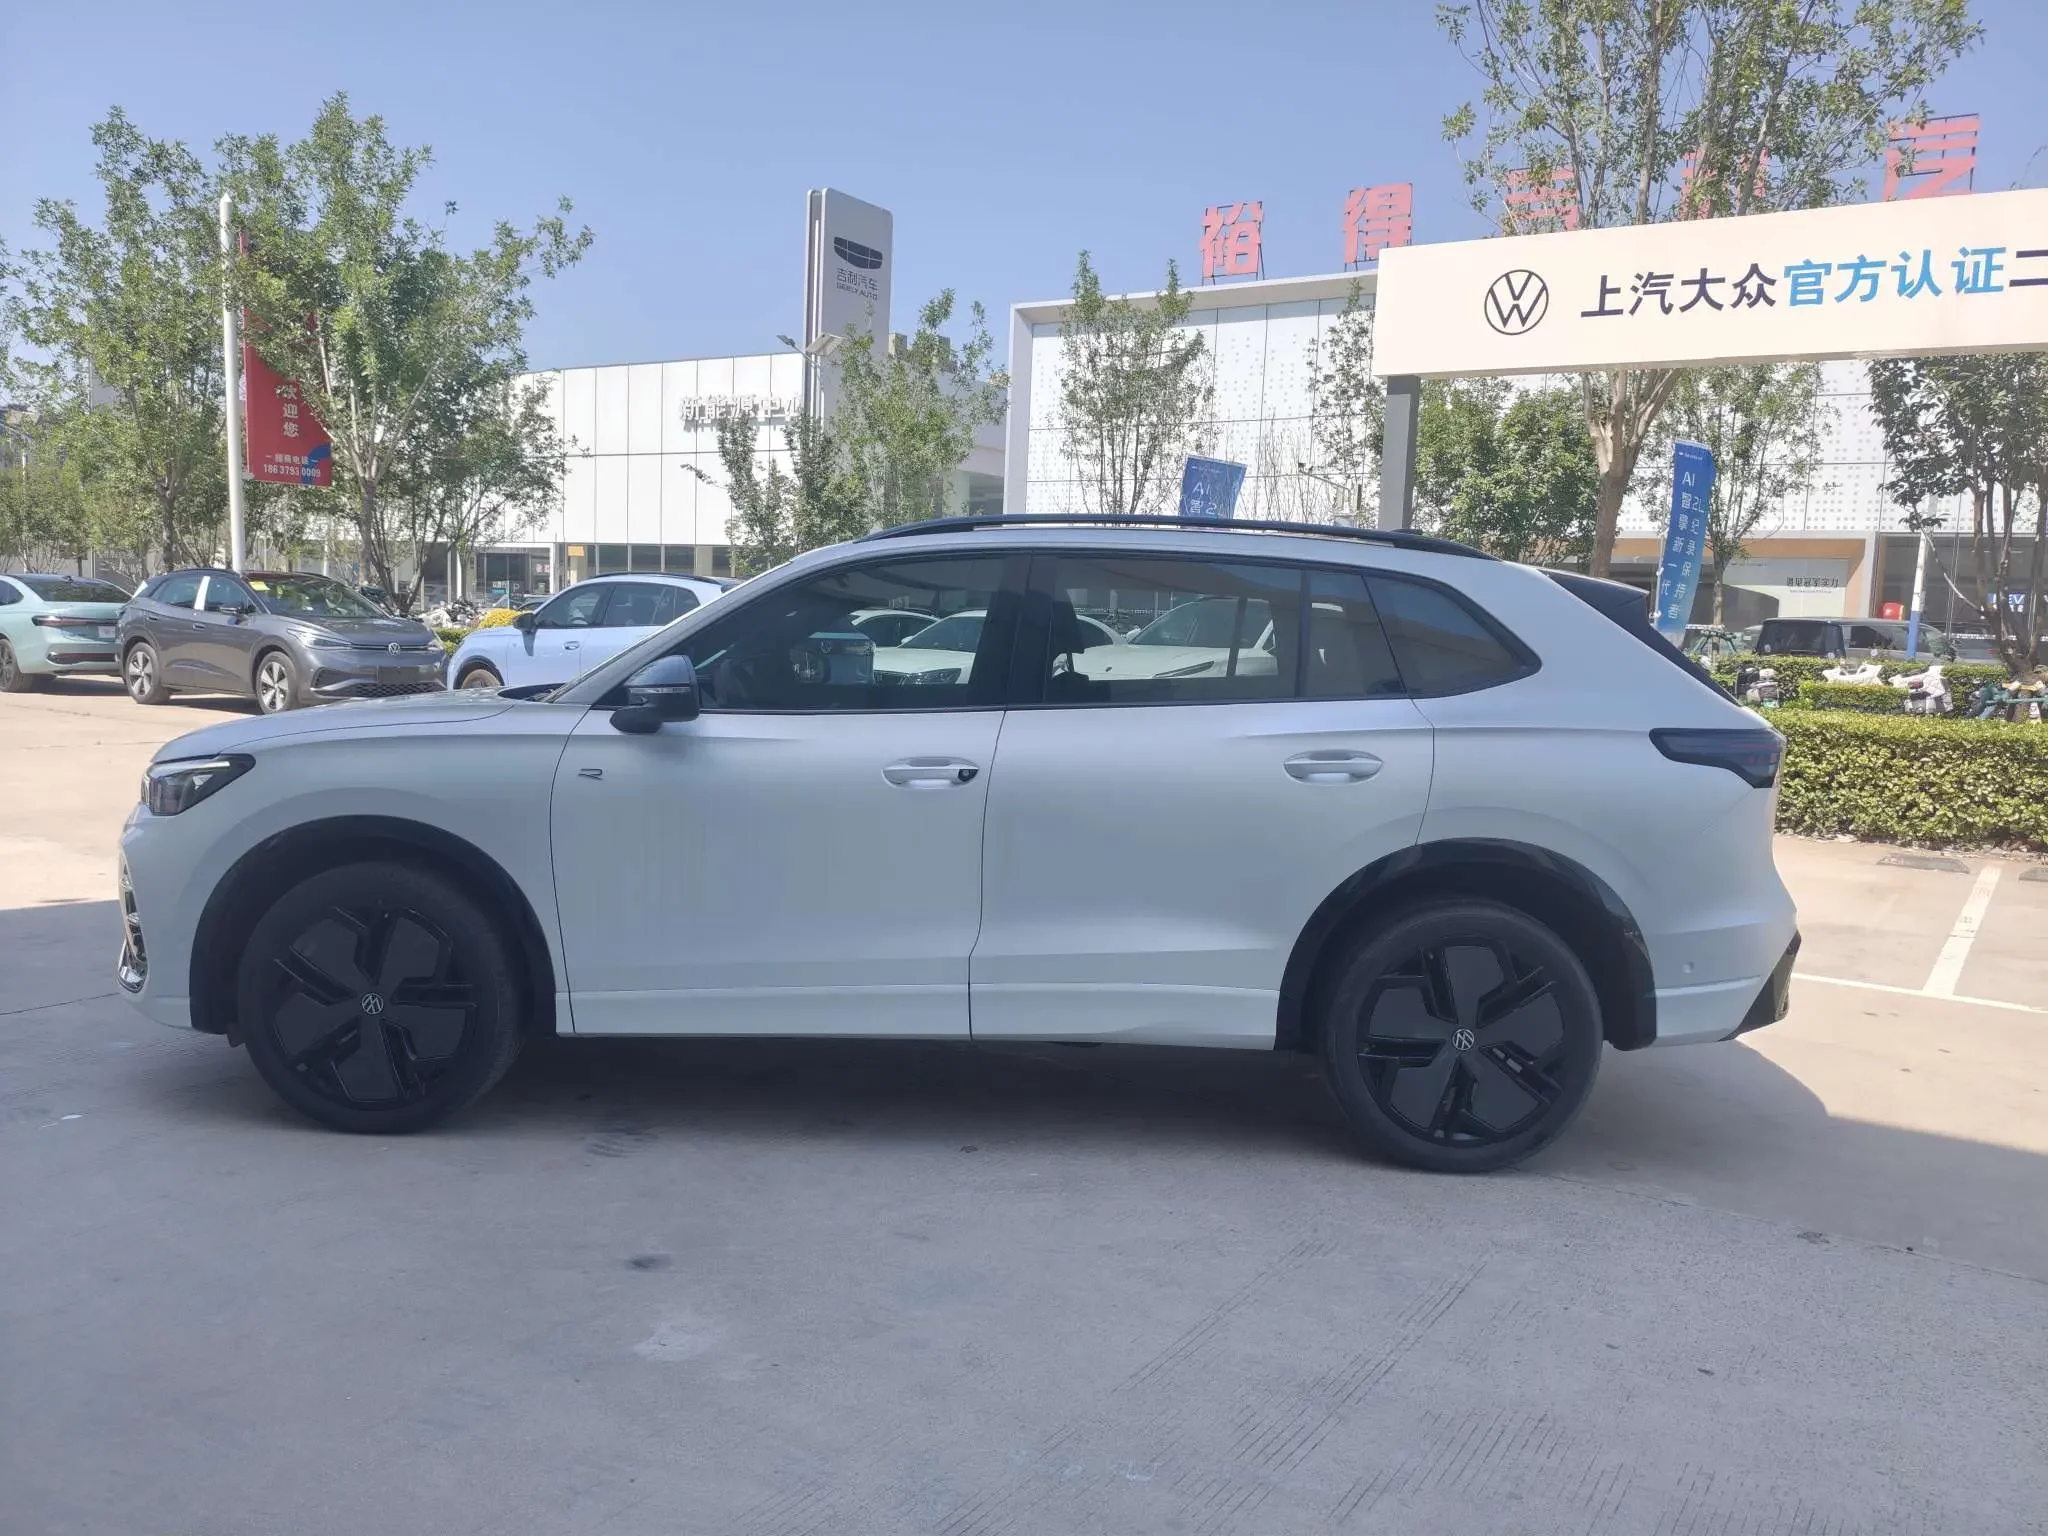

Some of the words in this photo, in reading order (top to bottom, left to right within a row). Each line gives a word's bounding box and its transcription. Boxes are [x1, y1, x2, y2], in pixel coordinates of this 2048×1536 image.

[836, 268, 879, 292] 吉利汽车
[1580, 247, 2048, 318] 上汽大众官方认证二
[859, 289, 878, 301] AUTO
[263, 464, 278, 474] 186
